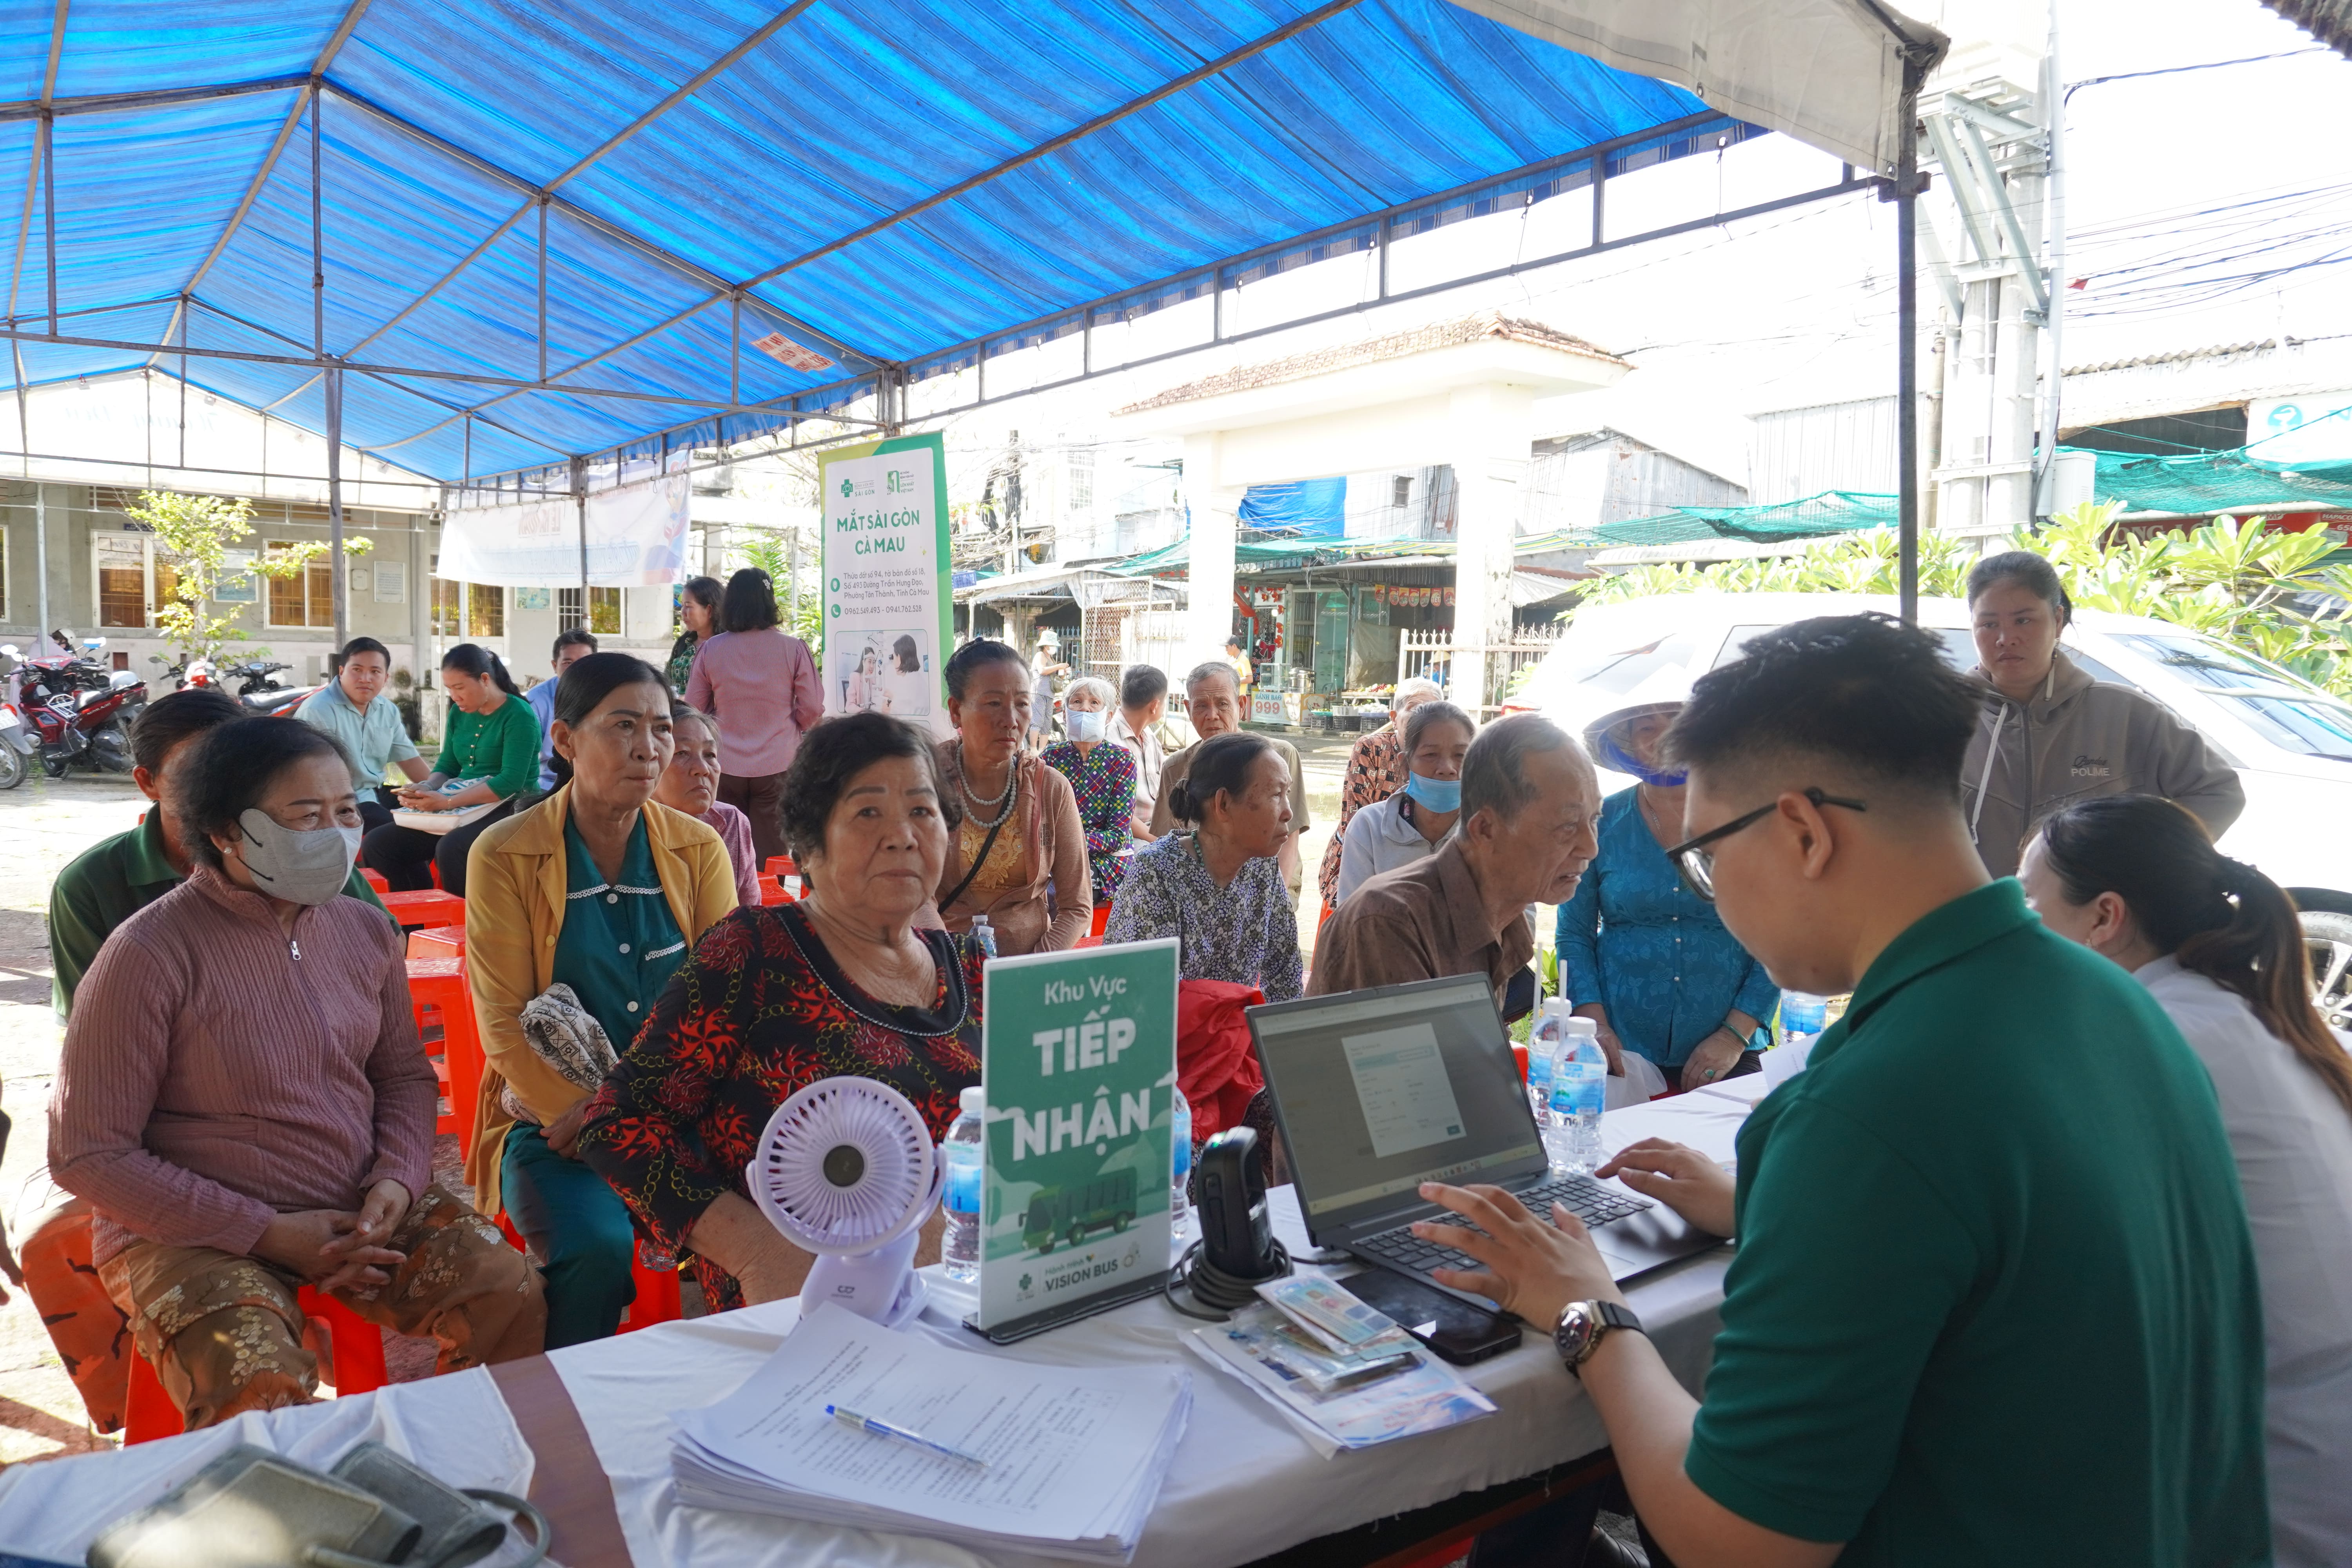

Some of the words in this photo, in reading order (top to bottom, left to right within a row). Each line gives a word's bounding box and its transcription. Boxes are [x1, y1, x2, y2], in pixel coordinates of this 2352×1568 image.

[837, 508, 865, 532] MẮT
[867, 509, 887, 530] SÀI
[891, 506, 920, 527] GÒN
[855, 535, 871, 555] CÀ
[874, 536, 905, 553] MAU
[844, 581, 851, 589] Số
[863, 580, 879, 589] Đường
[881, 579, 895, 587] Trần
[896, 579, 911, 587] Hưng
[911, 578, 924, 587] Đạo,
[859, 570, 867, 579] đất
[867, 570, 873, 578] số
[844, 592, 864, 600] Phường
[875, 590, 895, 598] Thành,
[897, 588, 908, 597] Tỉnh
[909, 588, 916, 596] Cà
[844, 606, 880, 615] 0962.549.493
[886, 605, 922, 613] 0941.762.528
[1255, 701, 1280, 715] 999
[1044, 979, 1085, 1005] Khu
[1088, 974, 1127, 1006] Vực
[1033, 1004, 1136, 1076] TIẾP
[1012, 1085, 1150, 1162] NHẬN
[1045, 1267, 1091, 1292] VISION
[1094, 1259, 1118, 1277] BUS
